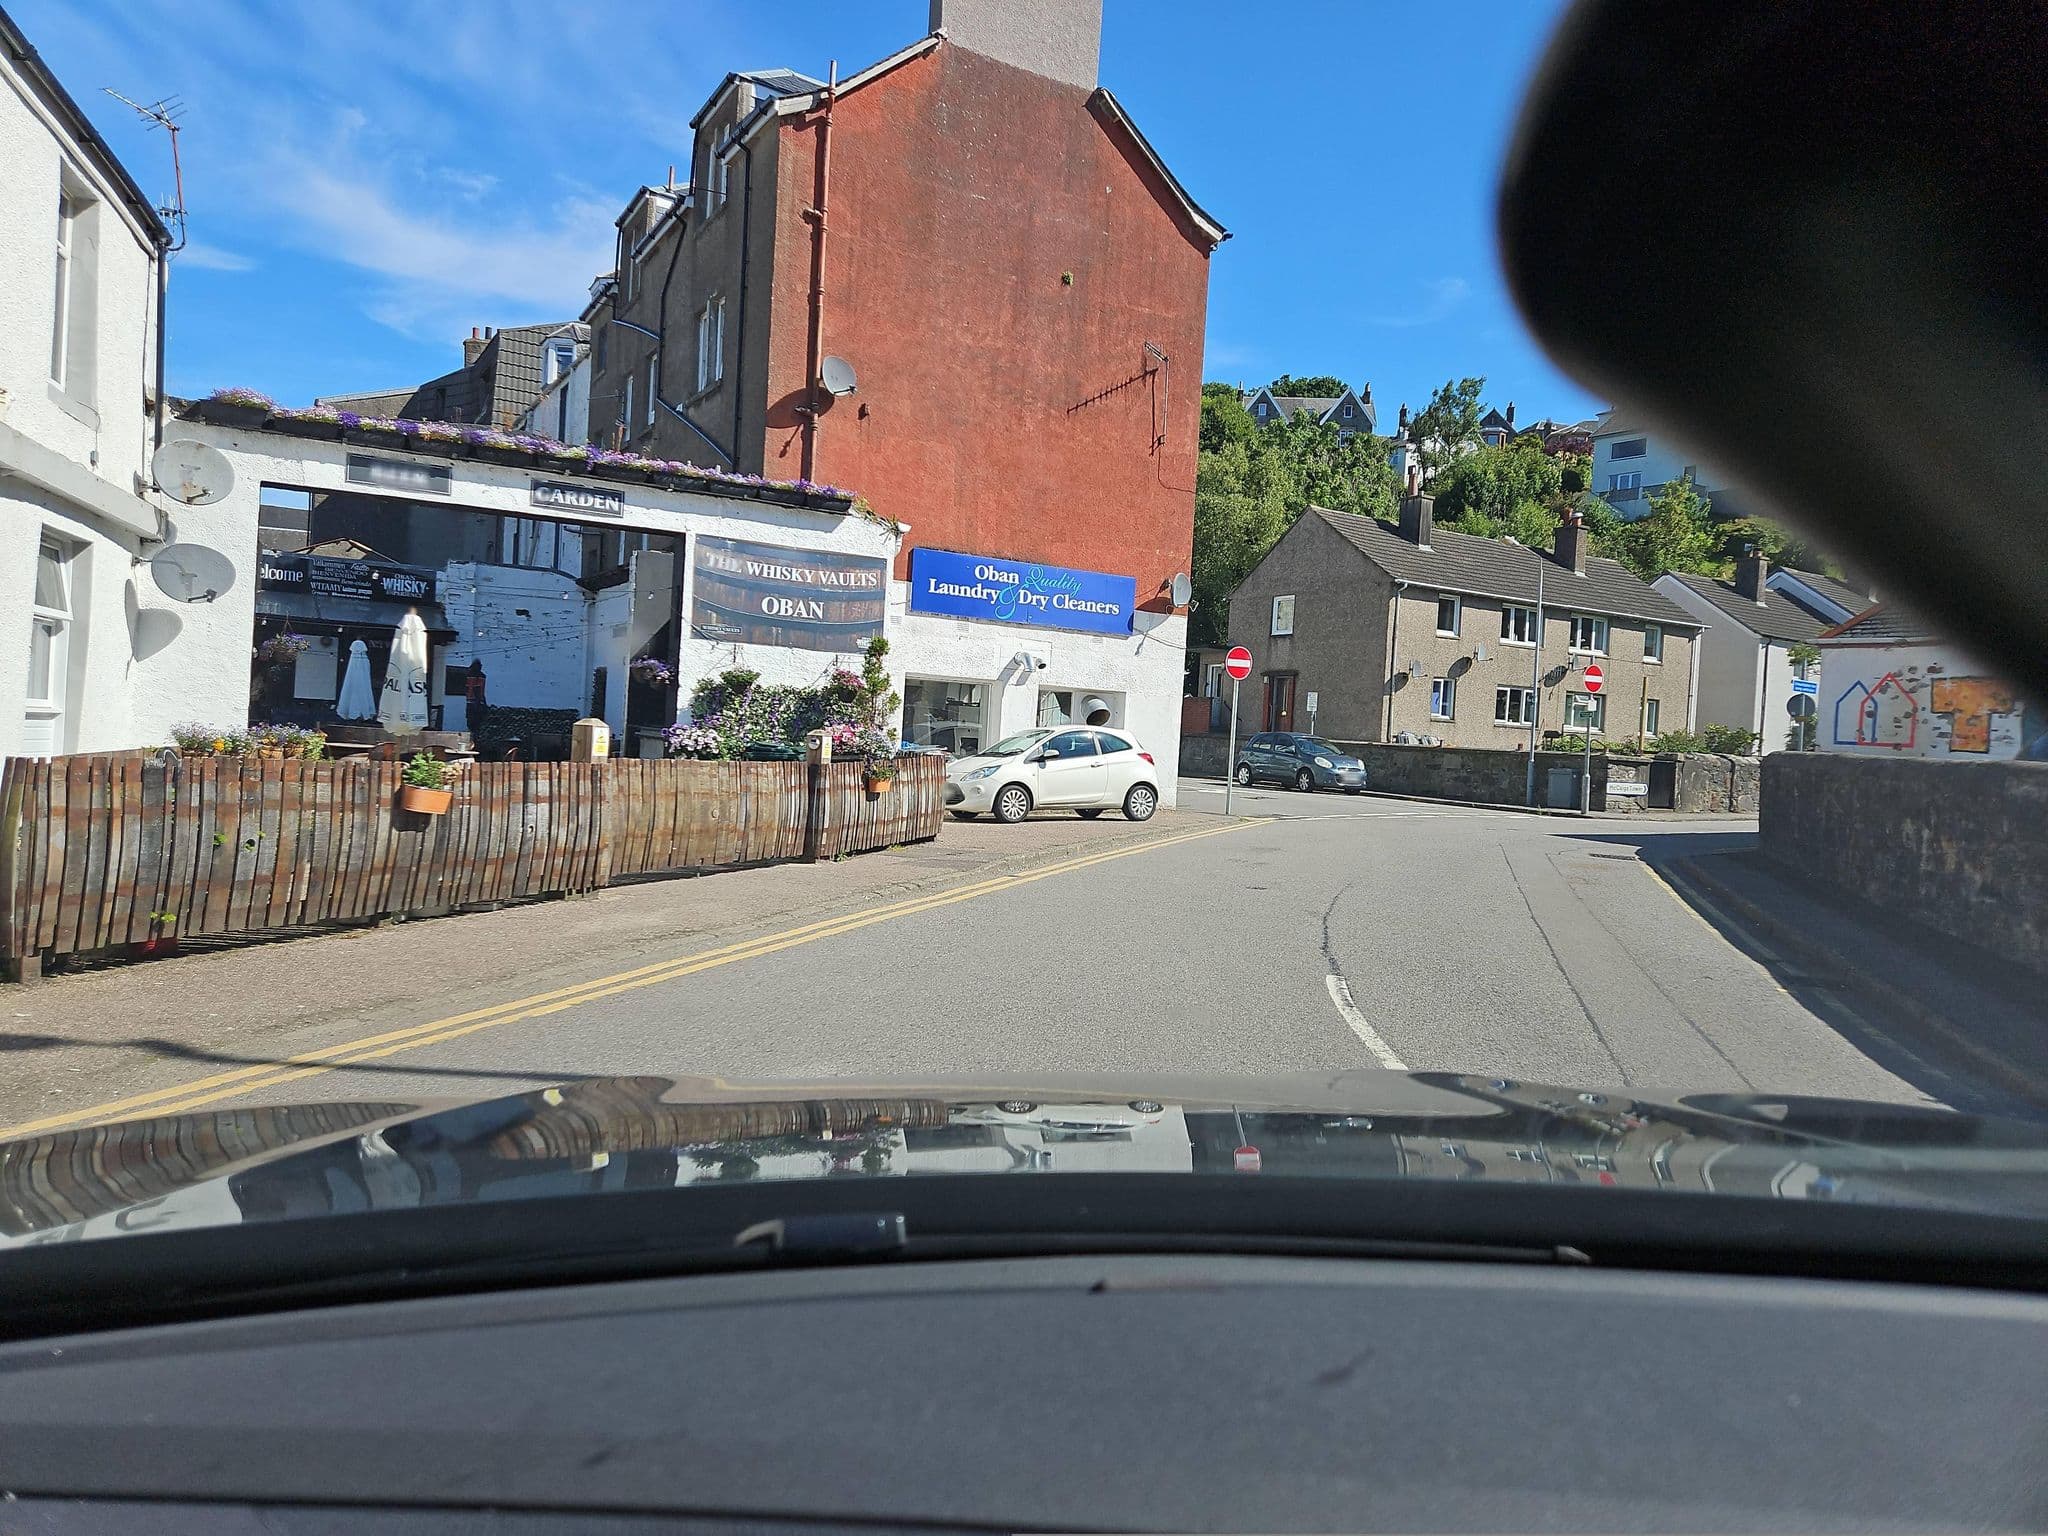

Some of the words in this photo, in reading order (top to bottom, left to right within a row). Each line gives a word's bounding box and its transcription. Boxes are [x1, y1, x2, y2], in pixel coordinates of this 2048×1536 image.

[260, 563, 304, 583] elcome
[706, 552, 742, 573] THE
[746, 561, 816, 583] WHISKY
[817, 571, 878, 587] VAULTS
[974, 564, 1020, 585] Oban
[1024, 566, 1083, 597] Quality
[383, 577, 428, 594] WHISKY
[928, 577, 1001, 605] Laundry
[1018, 589, 1050, 611] Dry
[1052, 594, 1121, 616] Cleaners
[761, 596, 825, 620] OBAN
